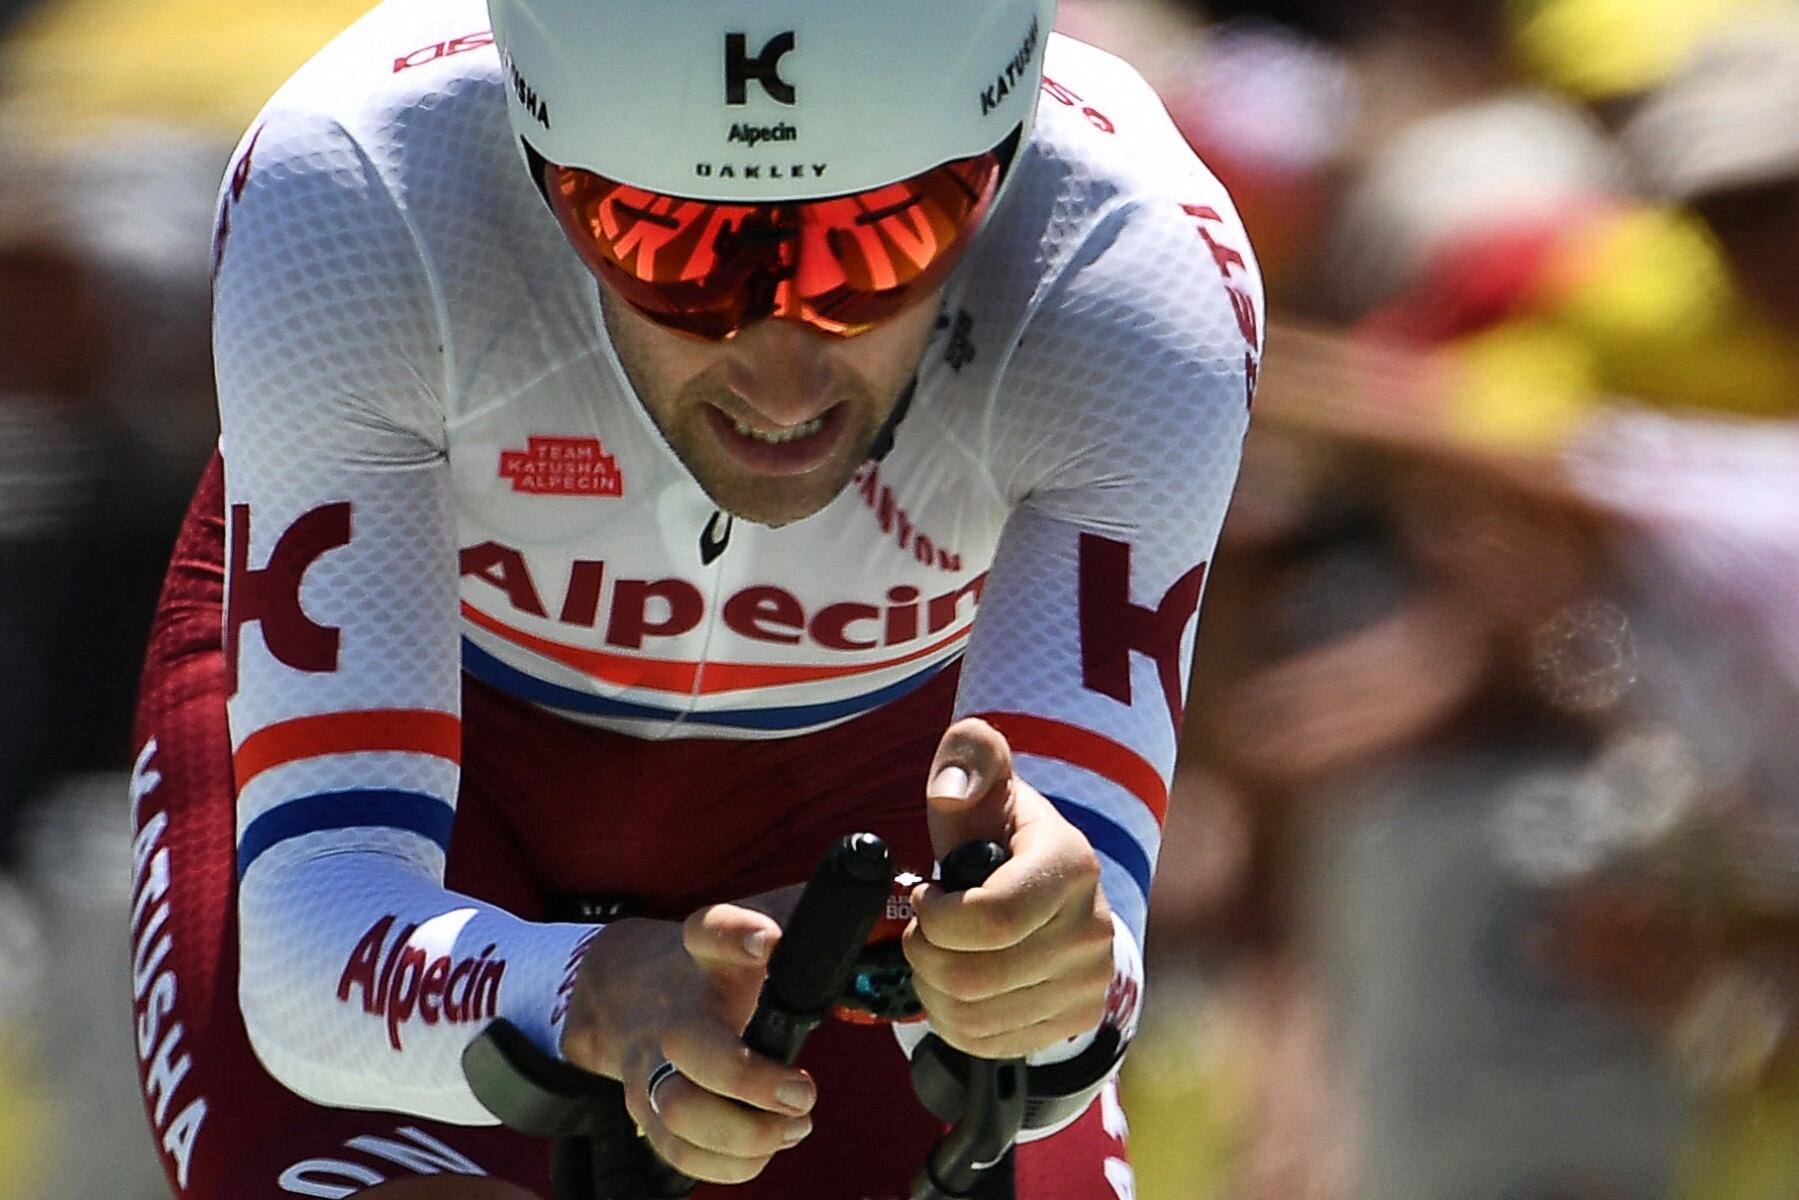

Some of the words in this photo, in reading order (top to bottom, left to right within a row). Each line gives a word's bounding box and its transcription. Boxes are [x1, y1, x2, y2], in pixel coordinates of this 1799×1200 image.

[728, 122, 797, 147] Alpecin
[696, 163, 827, 178] OAKLEY
[538, 446, 592, 459] TEAM
[508, 460, 606, 473] KATUSHA
[521, 476, 615, 489] ALPECIN
[337, 914, 506, 1051] Alpecin
